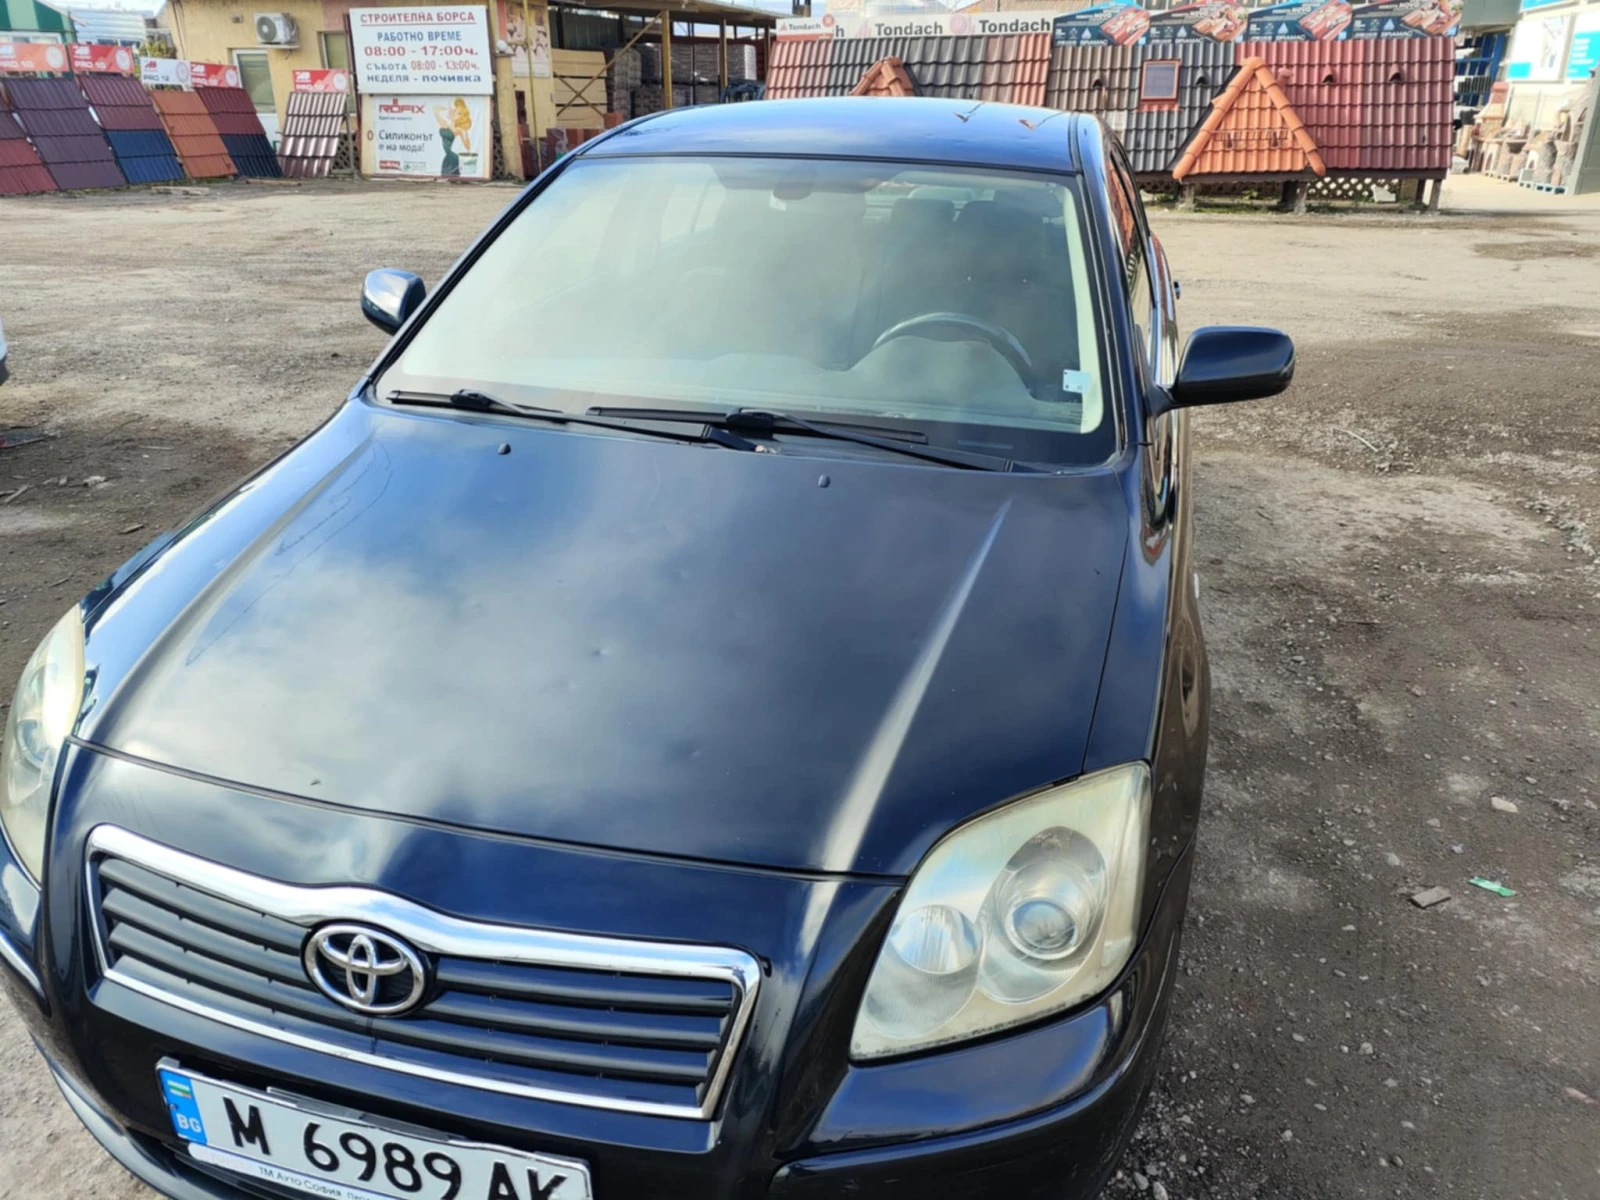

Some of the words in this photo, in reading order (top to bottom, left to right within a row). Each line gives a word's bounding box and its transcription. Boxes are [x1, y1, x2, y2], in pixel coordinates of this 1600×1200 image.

[360, 12, 433, 23] СТРОИТЕЛНА
[437, 11, 475, 22] БОРСА
[875, 21, 943, 36] Tondach
[979, 18, 1051, 33] Tondach
[377, 31, 423, 42] РАБОТНО
[428, 31, 462, 41] ВРЕМЕ
[364, 46, 406, 56] 08:00
[366, 62, 408, 71] СЪБОТА
[411, 60, 436, 70] 08:00
[367, 75, 409, 83] НЕДЕЛЯ
[379, 129, 433, 141] Силиконът
[399, 143, 425, 153] мода!
[177, 1113, 201, 1133] BG
[223, 1095, 270, 1156] M
[304, 1122, 462, 1200] 6989
[304, 1181, 342, 1197] София
